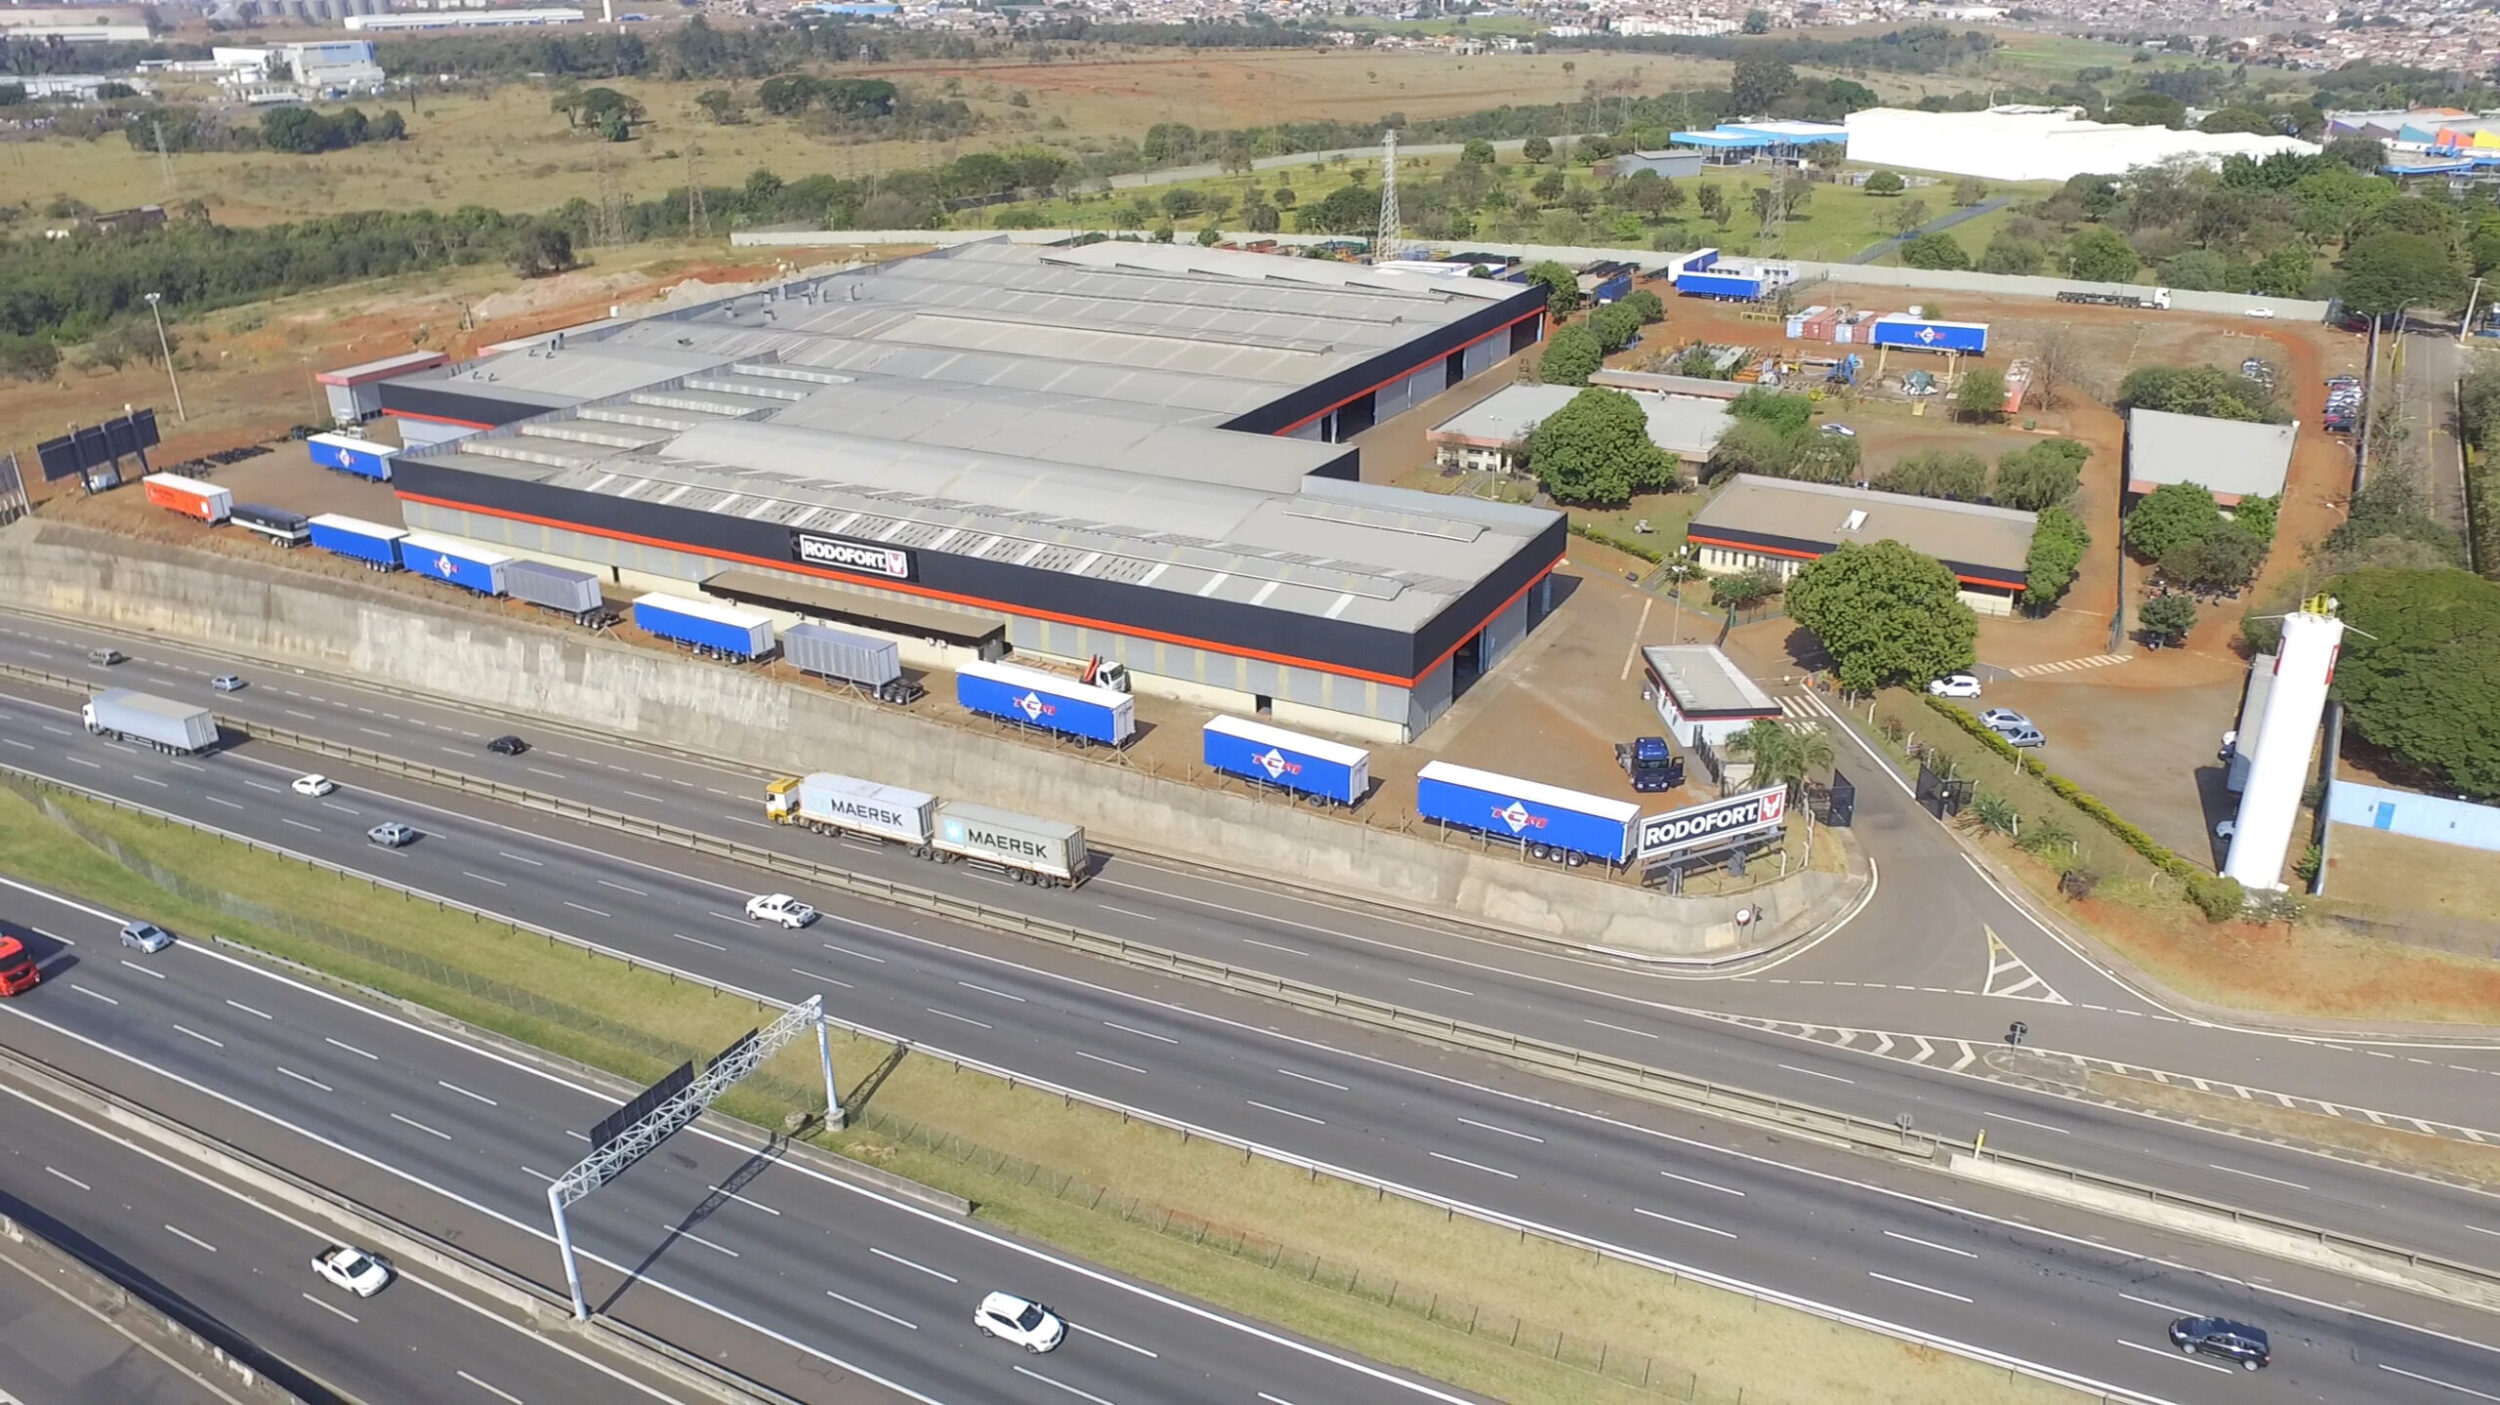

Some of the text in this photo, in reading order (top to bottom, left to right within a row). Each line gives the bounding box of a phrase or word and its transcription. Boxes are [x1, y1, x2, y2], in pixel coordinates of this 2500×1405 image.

[804, 540, 886, 569] RODOFORT
[831, 798, 903, 826] MAERSK
[1646, 802, 1758, 846] RODOFORT
[968, 828, 1047, 858] MAERSK
